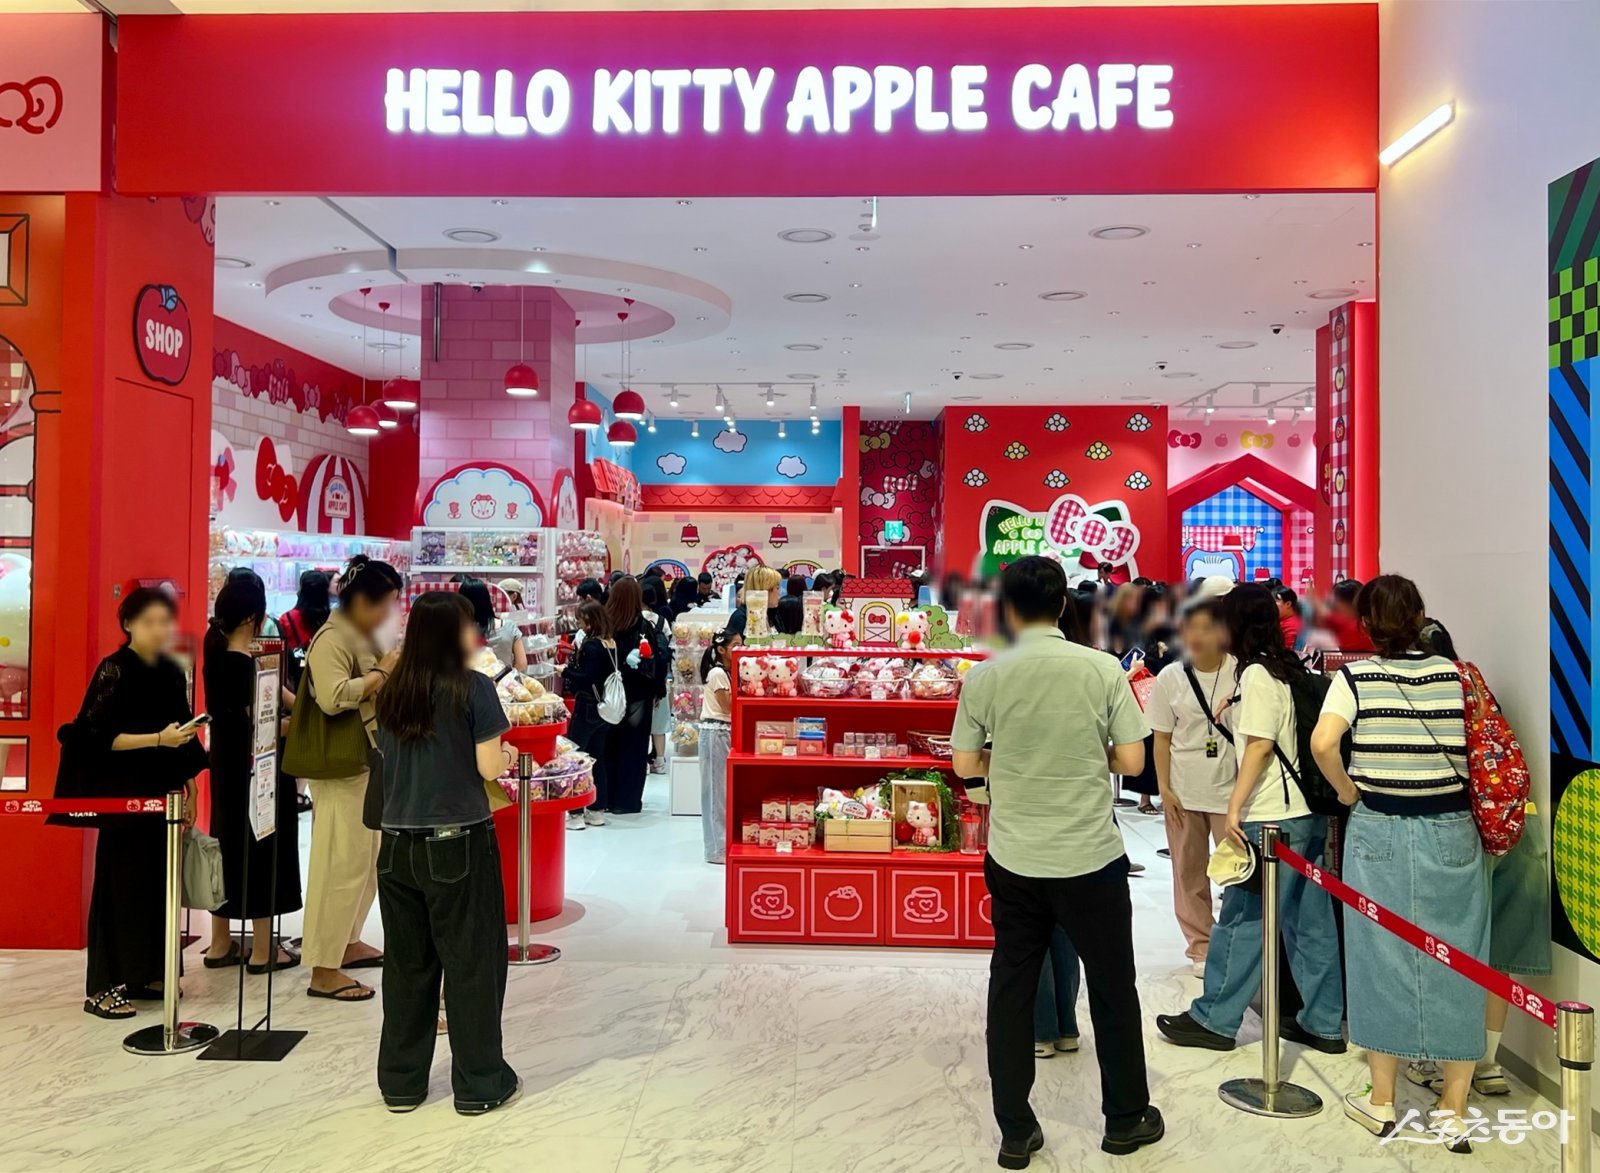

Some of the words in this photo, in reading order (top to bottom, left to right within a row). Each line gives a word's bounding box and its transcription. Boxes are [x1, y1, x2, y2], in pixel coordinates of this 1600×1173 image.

[384, 68, 570, 135] HELLO
[593, 67, 774, 133] KITTY
[786, 65, 987, 132] APPLE
[1012, 63, 1173, 130] CAFE
[145, 318, 183, 358] SHOP
[998, 515, 1033, 534] HELLO
[993, 540, 1040, 555] APPLE
